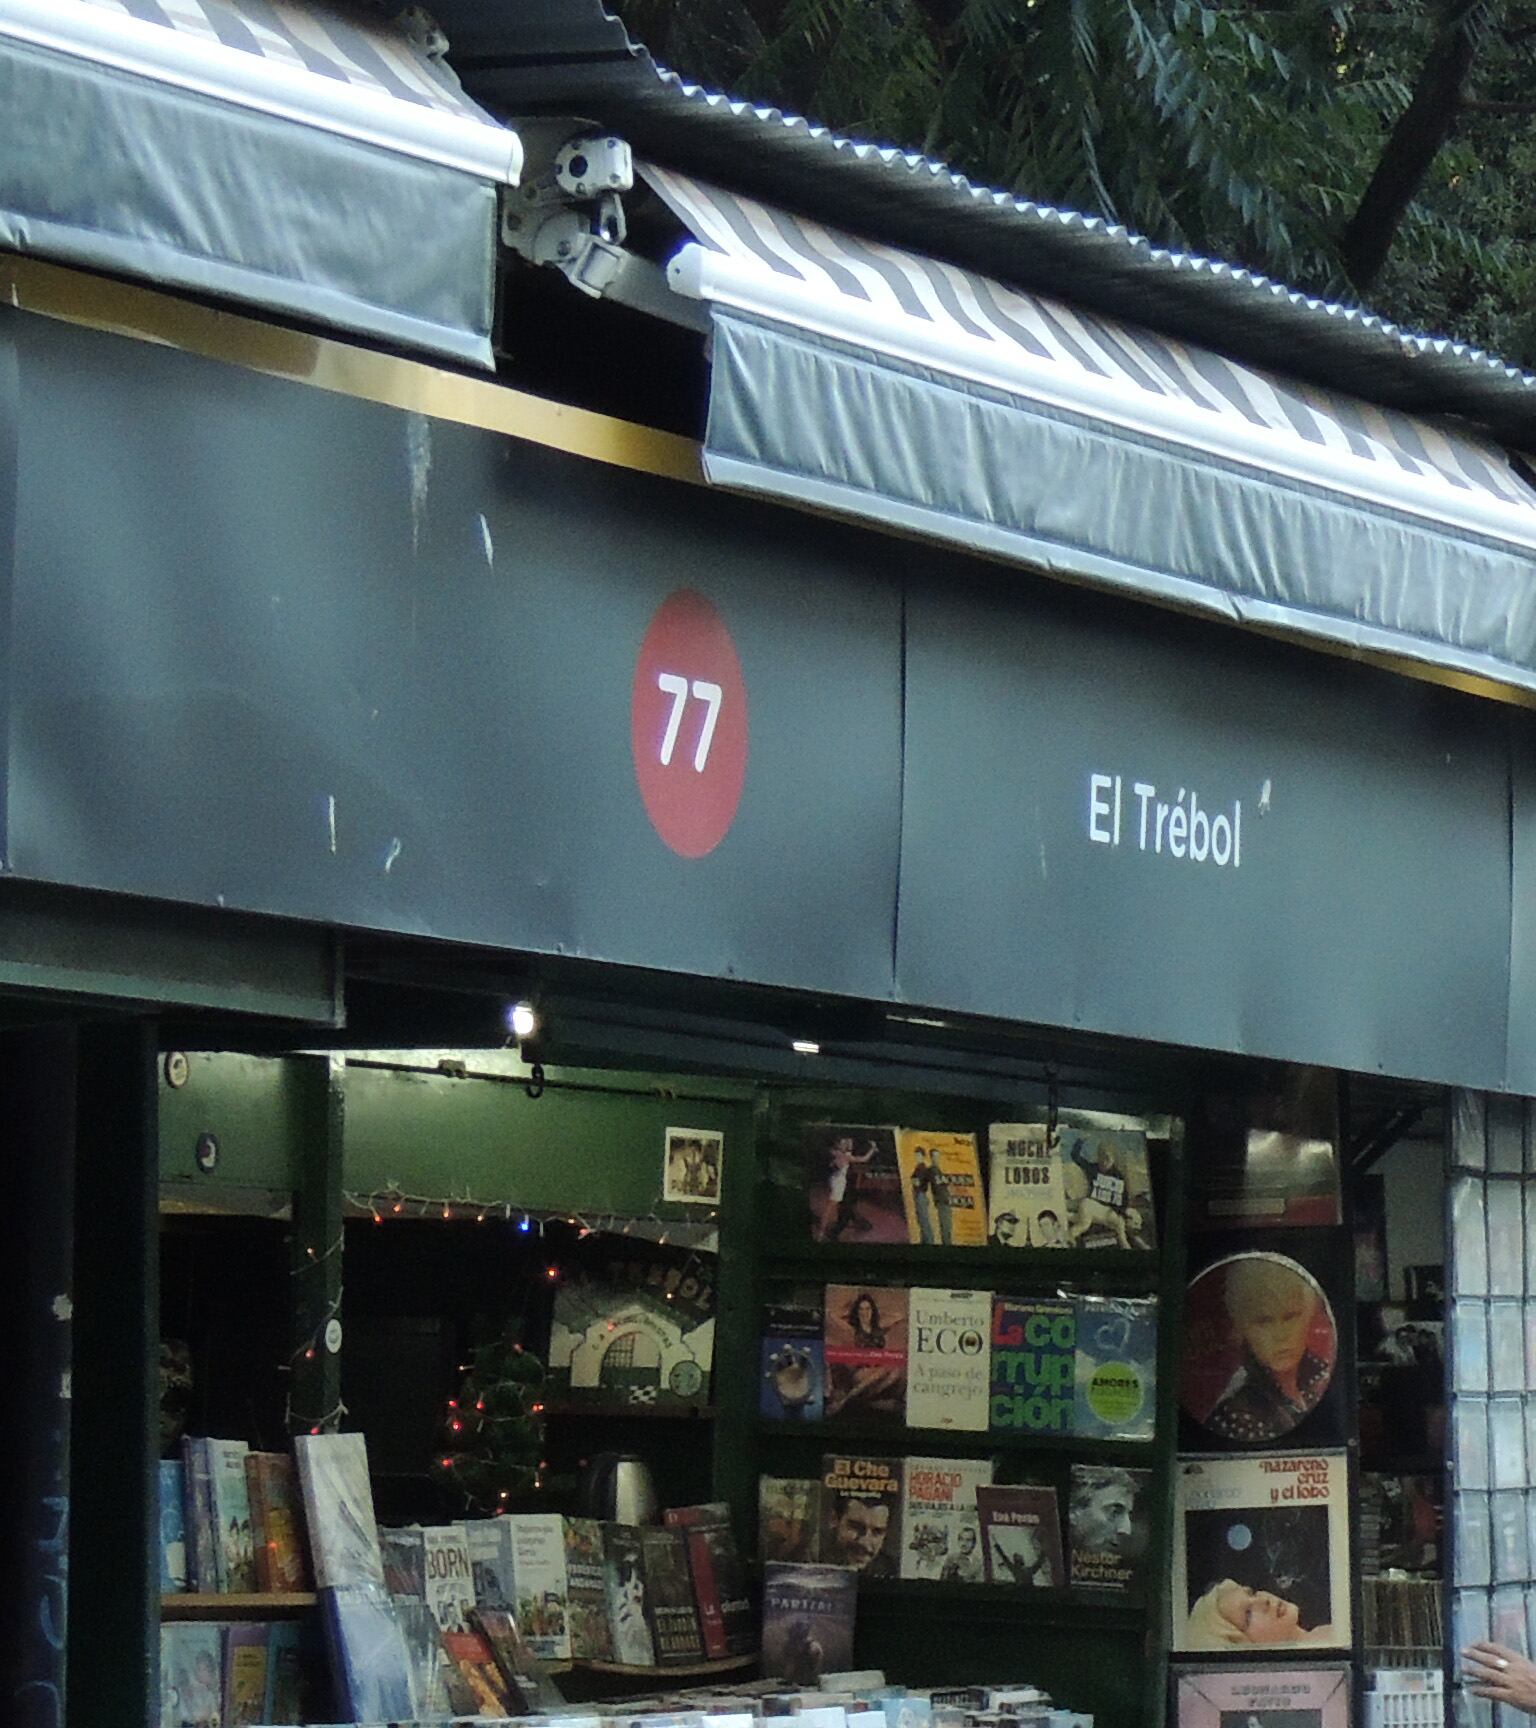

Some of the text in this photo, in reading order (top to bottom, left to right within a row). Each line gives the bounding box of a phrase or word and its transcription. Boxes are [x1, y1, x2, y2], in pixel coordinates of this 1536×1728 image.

[658, 672, 723, 774] 77
[1089, 773, 1241, 868] El Trébol
[1005, 1167, 1050, 1184] LOBOS
[916, 1311, 984, 1327] Umberto
[917, 1327, 983, 1356] ECO
[834, 1459, 890, 1477] El Che
[825, 1473, 898, 1492] Guevara
